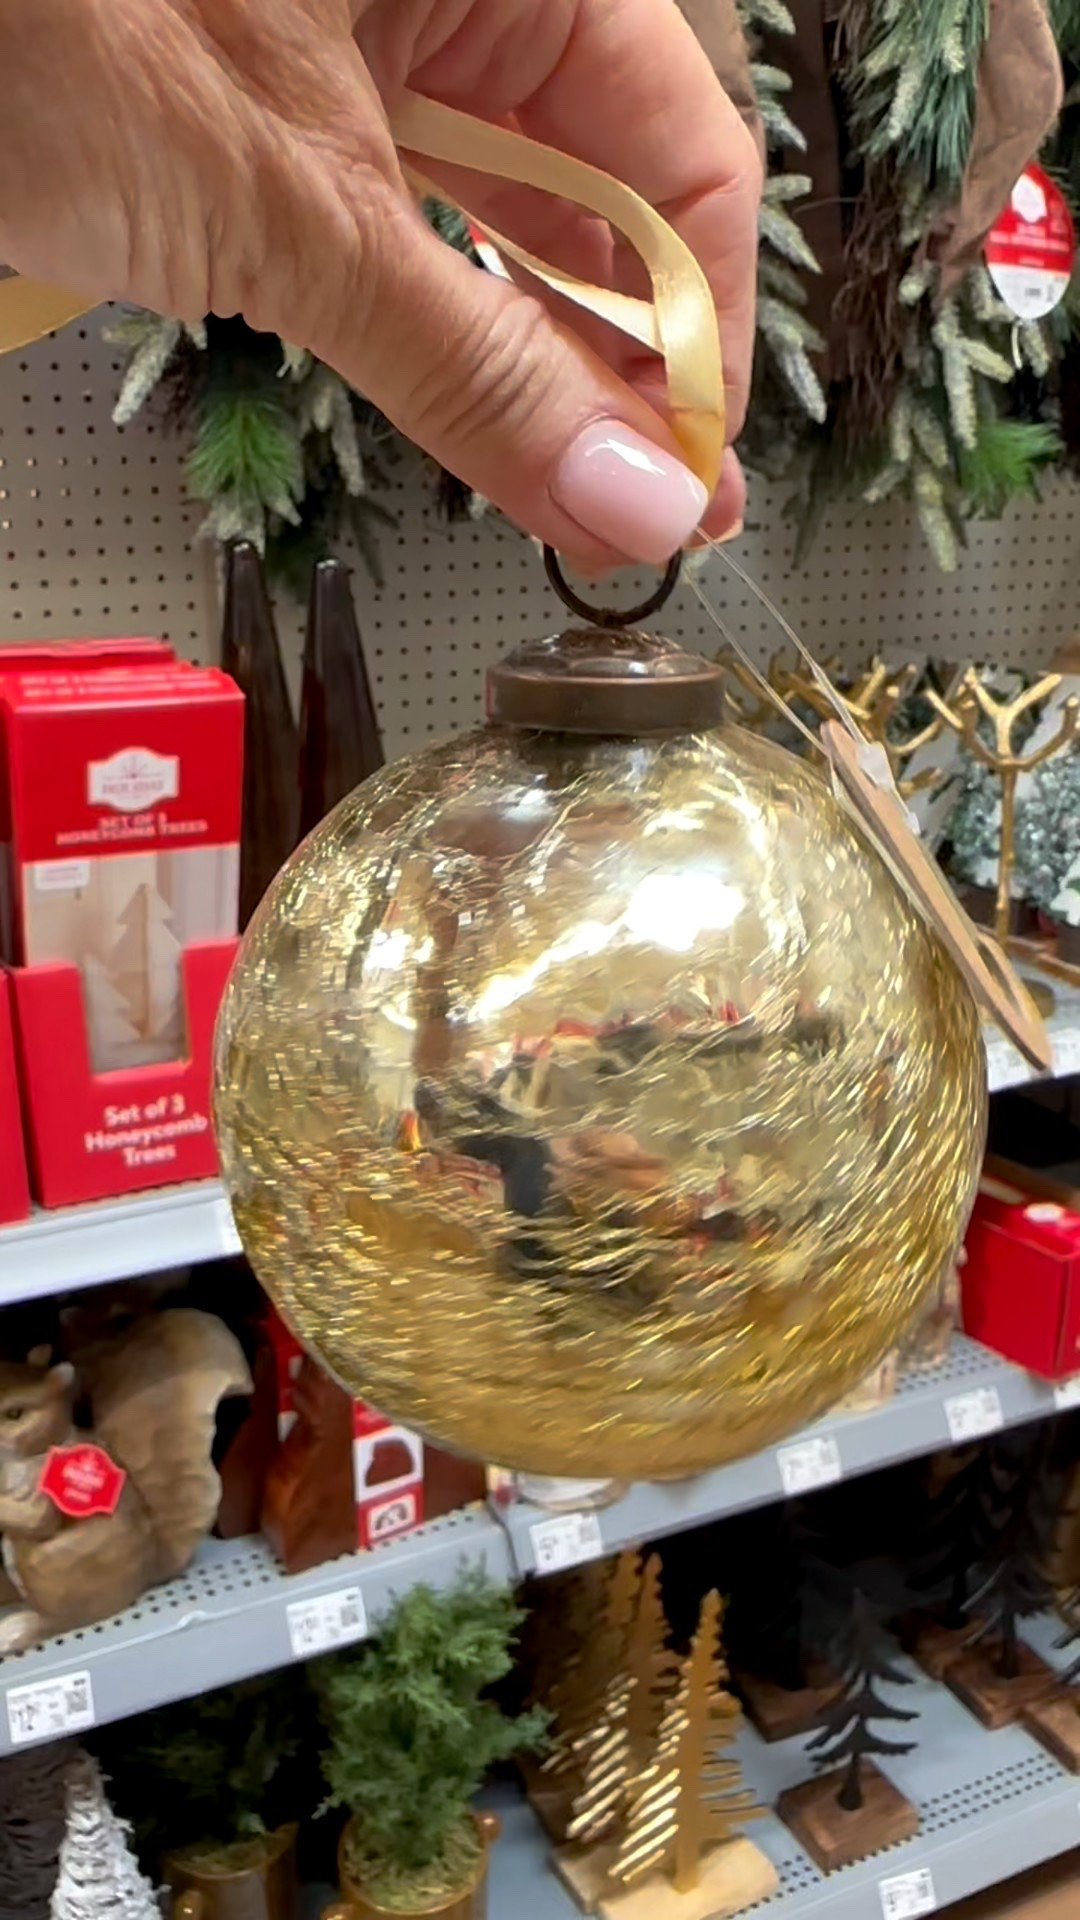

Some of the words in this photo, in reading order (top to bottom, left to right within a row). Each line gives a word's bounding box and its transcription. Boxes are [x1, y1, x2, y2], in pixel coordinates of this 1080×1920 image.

[104, 1106, 141, 1127] Set
[144, 1096, 168, 1119] of
[171, 1093, 185, 1114] 3
[85, 1113, 207, 1151] Honeycomb
[123, 1144, 176, 1165] Trees
